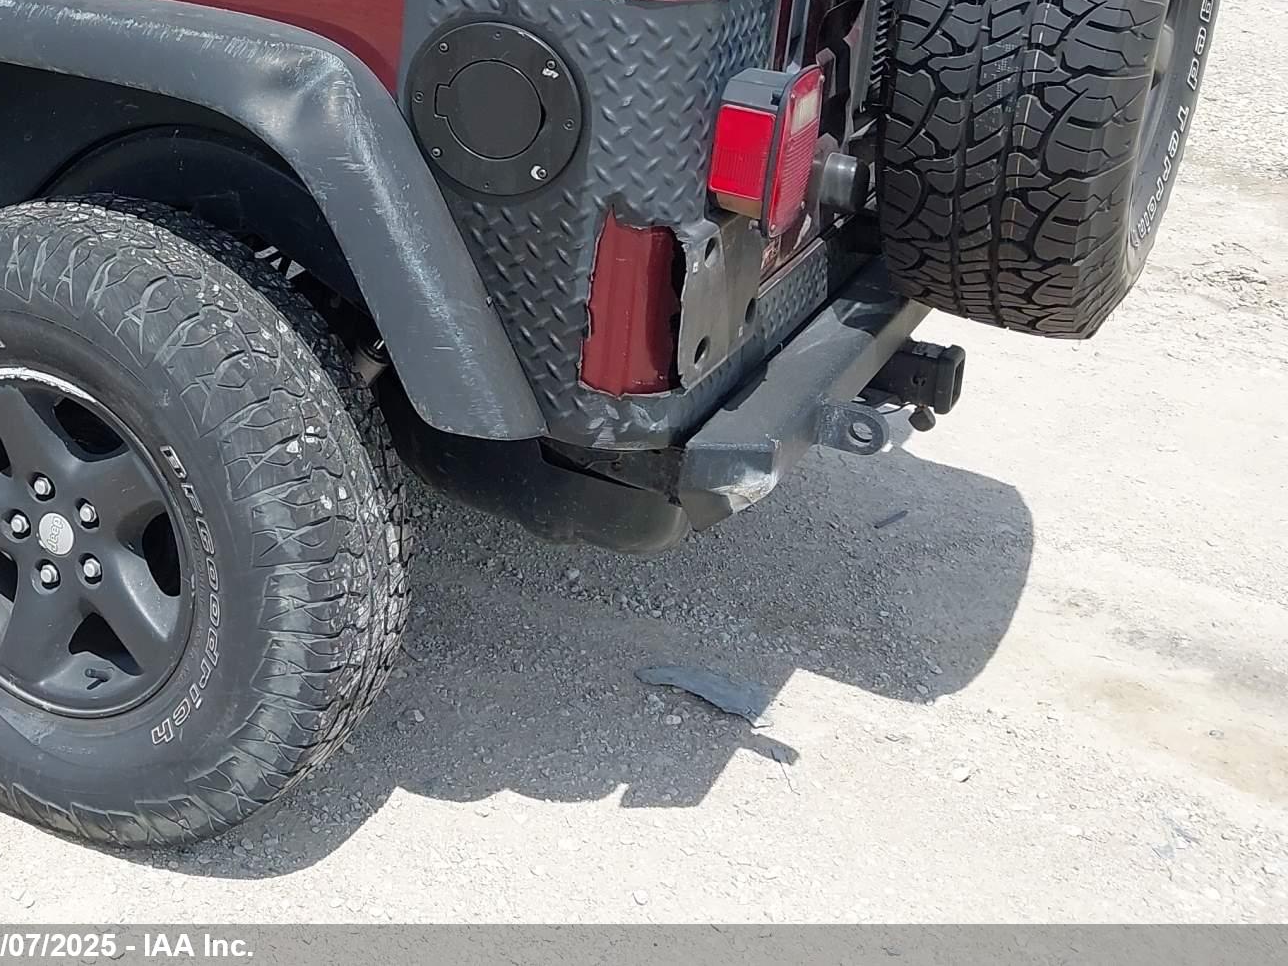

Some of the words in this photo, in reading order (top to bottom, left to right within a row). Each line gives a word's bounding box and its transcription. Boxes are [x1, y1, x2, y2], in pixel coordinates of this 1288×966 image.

[1137, 105, 1190, 240] Terrain
[46, 516, 64, 553] Jeep
[152, 445, 222, 746] BFGoodrich
